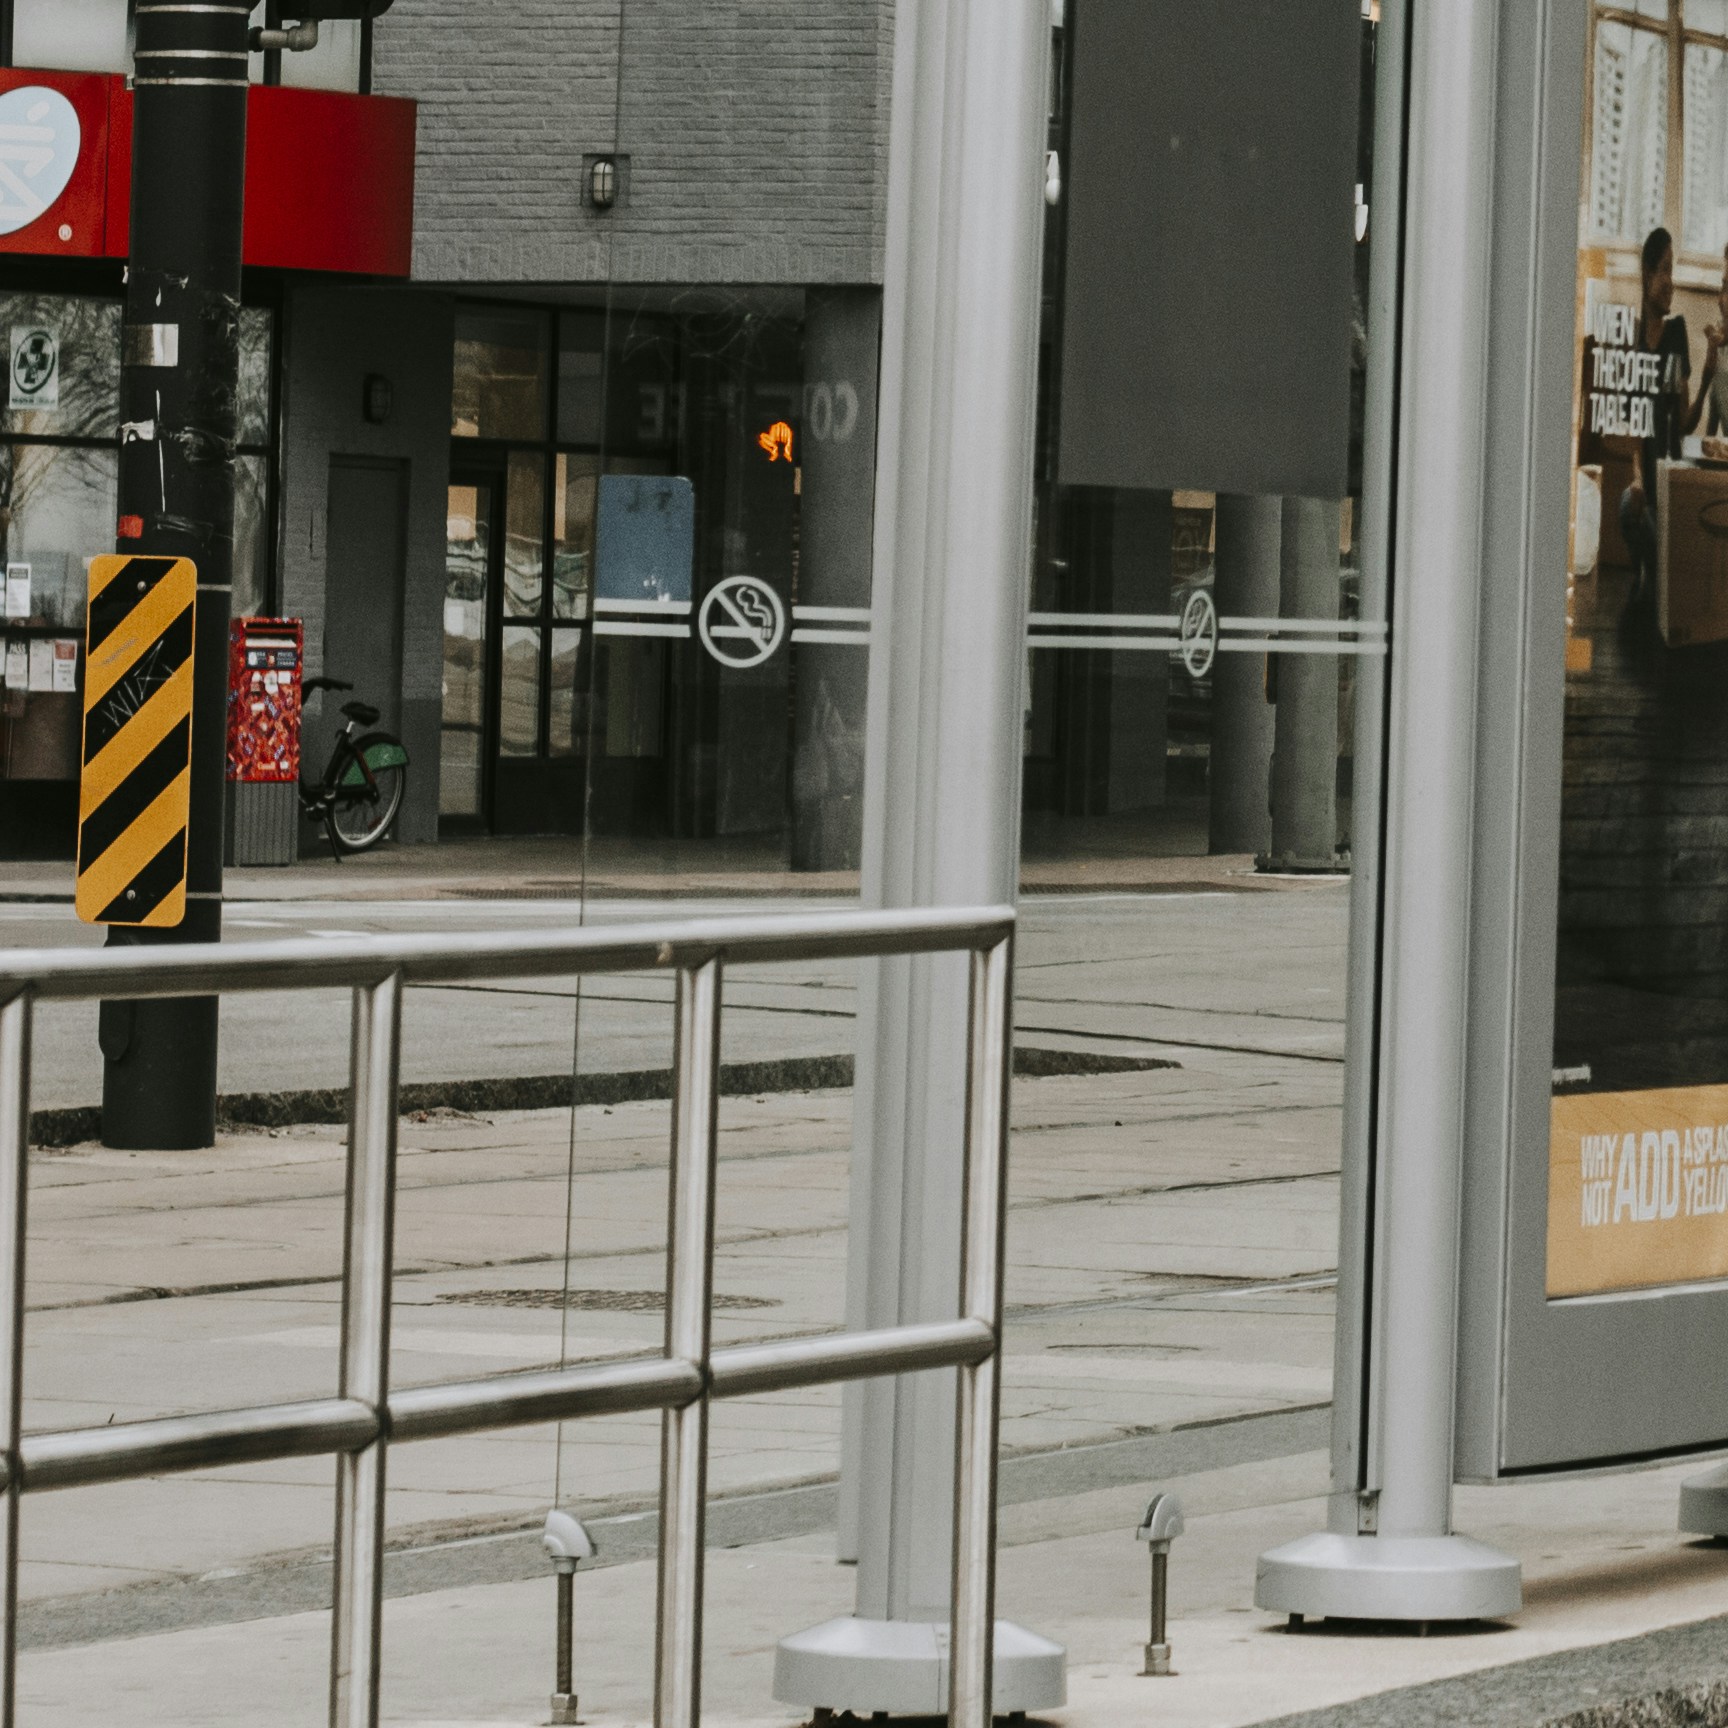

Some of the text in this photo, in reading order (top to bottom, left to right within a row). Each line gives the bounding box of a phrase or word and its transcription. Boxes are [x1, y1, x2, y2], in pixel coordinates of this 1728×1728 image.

[1589, 392, 1629, 437] TABLE
[1581, 1132, 1619, 1180] WHY
[1683, 1127, 1693, 1165] A
[1612, 1128, 1681, 1224] ADD
[1581, 1180, 1613, 1228] NOT
